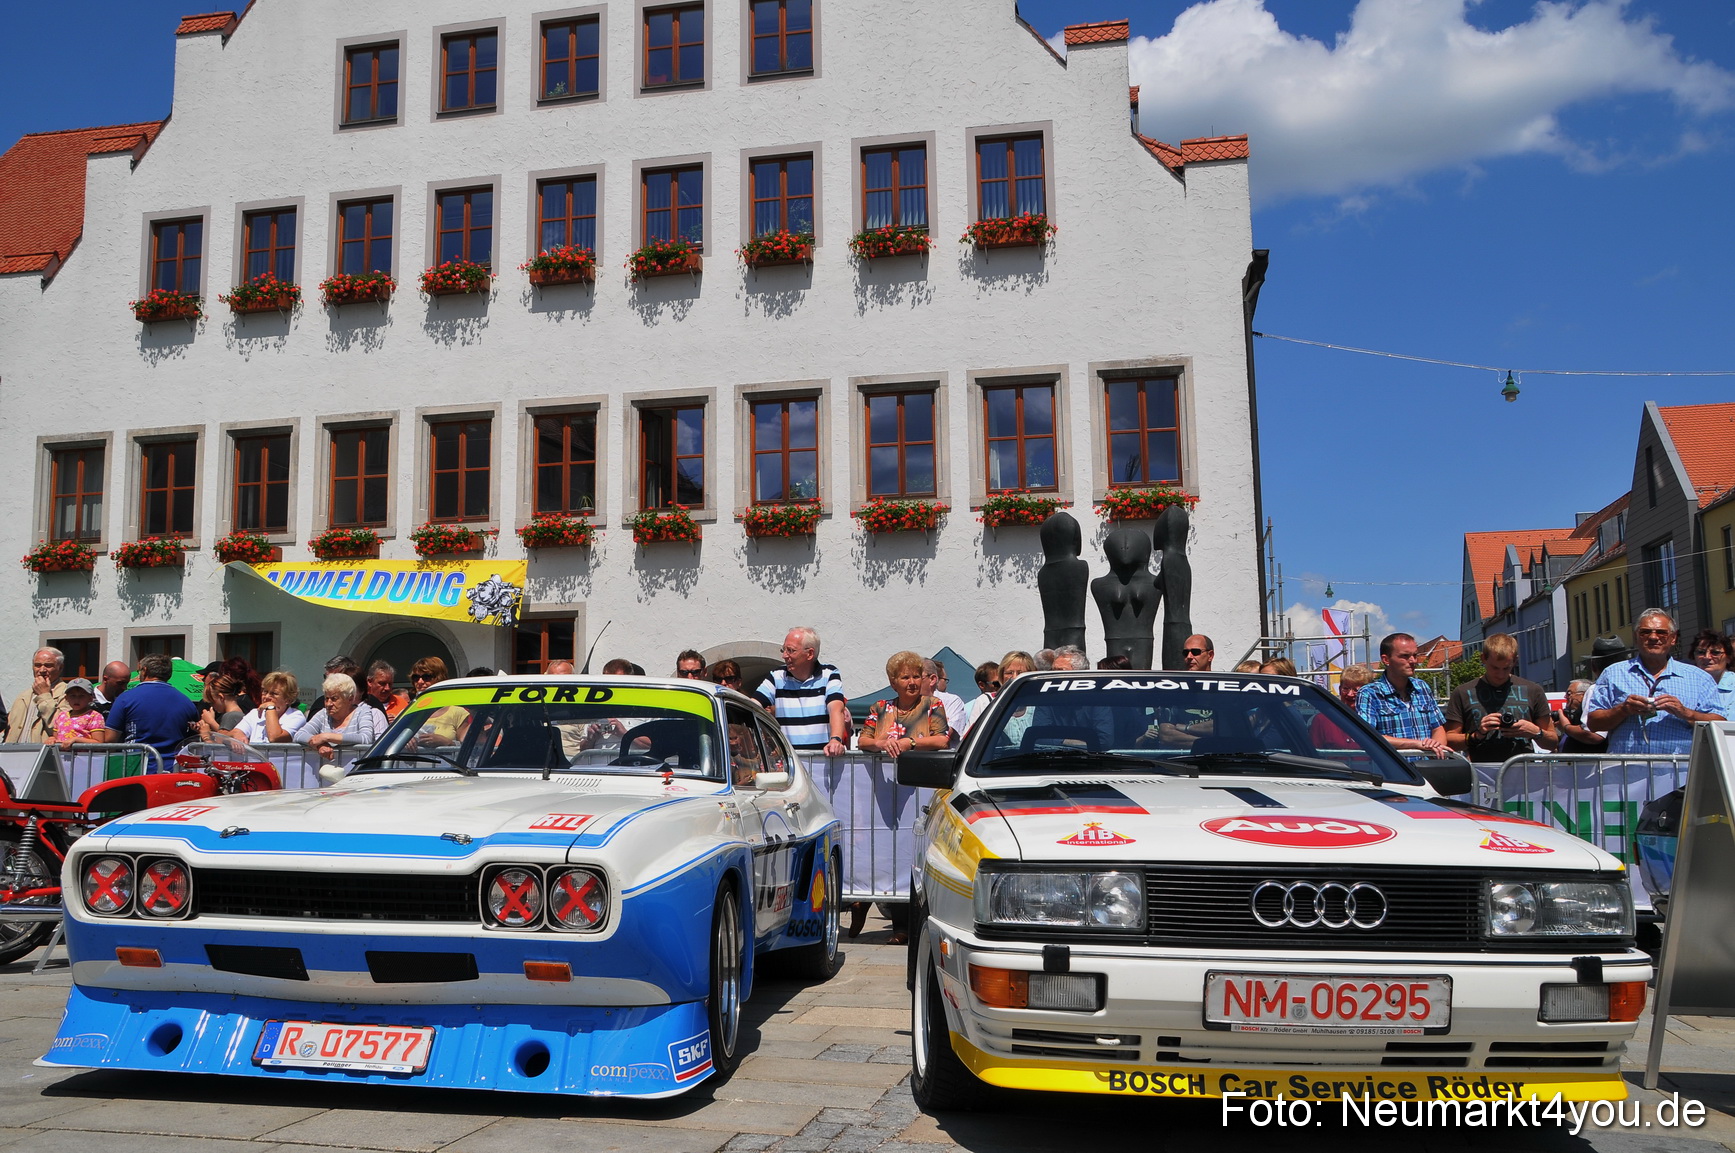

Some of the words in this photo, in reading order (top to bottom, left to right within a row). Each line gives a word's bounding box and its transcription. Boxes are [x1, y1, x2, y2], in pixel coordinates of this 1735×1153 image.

[491, 687, 614, 703] FORD
[1040, 680, 1097, 692] HB
[1194, 681, 1302, 696] TEAM
[535, 814, 584, 829] RTL
[1078, 829, 1114, 840] HB
[1489, 835, 1530, 847] HB
[786, 919, 823, 938] BOSCH
[1223, 978, 1431, 1021] NM-06295
[262, 1044, 270, 1053] D
[278, 1026, 303, 1055] R
[320, 1028, 423, 1062] 07577
[678, 1039, 708, 1066] SKF
[1109, 1069, 1206, 1095] BOSCH
[1218, 1073, 1279, 1096] Car
[1289, 1074, 1416, 1100] Service
[1428, 1073, 1525, 1100] Röder
